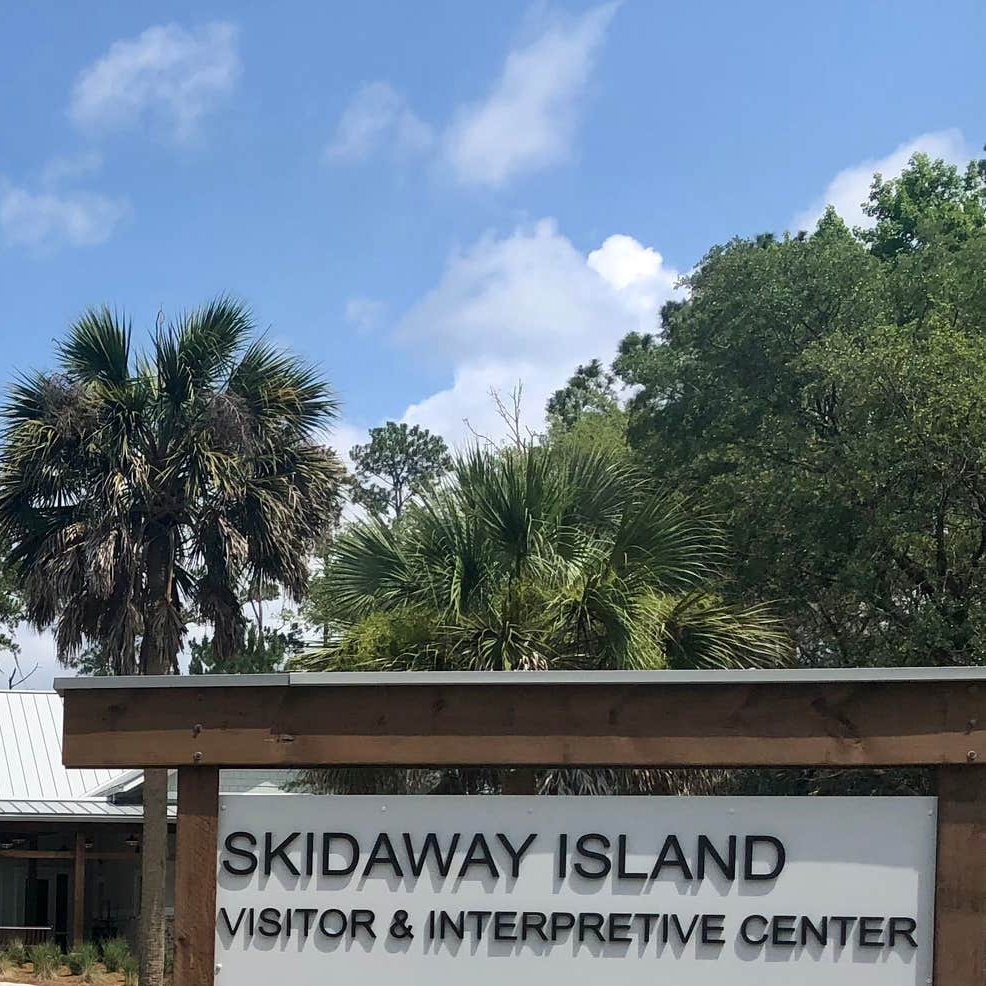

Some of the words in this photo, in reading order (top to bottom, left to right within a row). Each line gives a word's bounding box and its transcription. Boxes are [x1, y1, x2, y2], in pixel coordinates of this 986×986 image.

[222, 831, 538, 878] SKIDAWAY
[558, 833, 787, 882] ISLAND
[218, 907, 377, 940] VISITOR
[389, 909, 415, 940] &
[428, 910, 726, 946] INTERPRETIVE
[739, 914, 919, 949] CENTER
